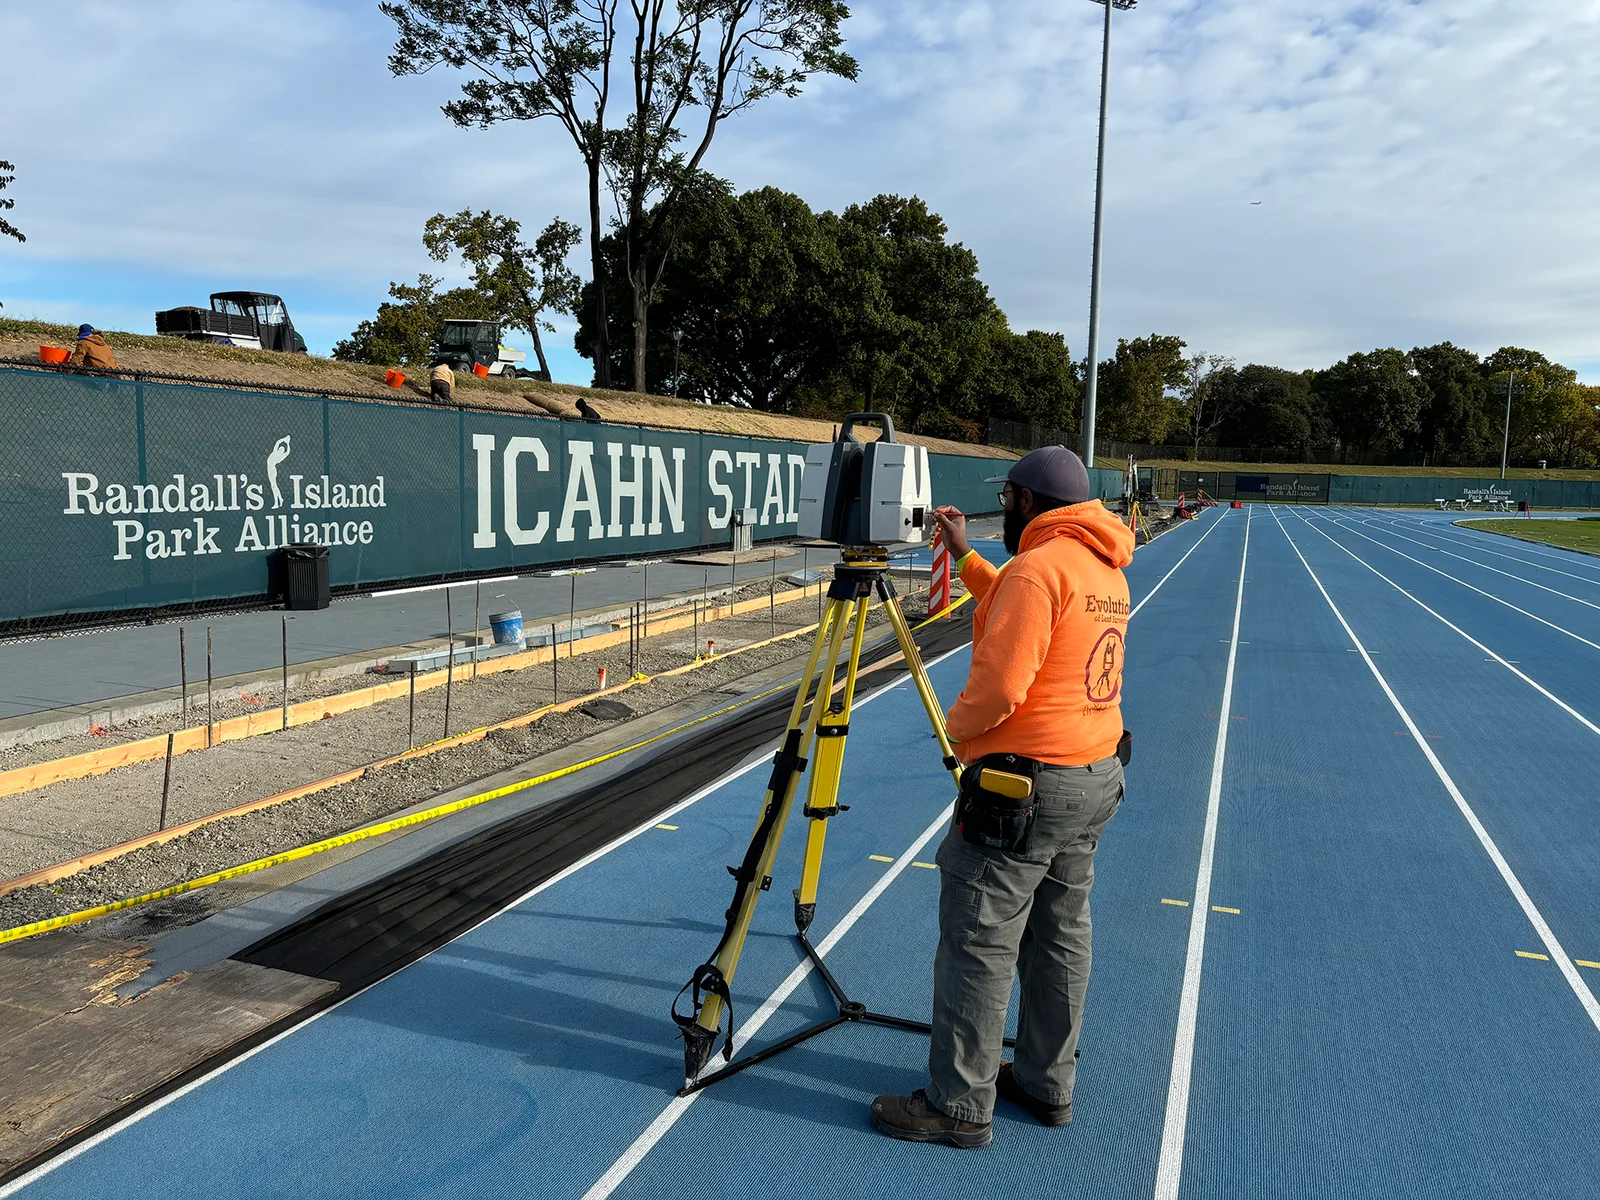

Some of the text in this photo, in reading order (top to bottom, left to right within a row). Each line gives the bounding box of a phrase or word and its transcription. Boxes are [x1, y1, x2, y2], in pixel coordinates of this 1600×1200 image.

[62, 472, 387, 515] Randall's Island
[472, 433, 804, 549] ICAHN STAD
[113, 514, 374, 561] Park Alliance
[1084, 595, 1129, 615] Evolutio
